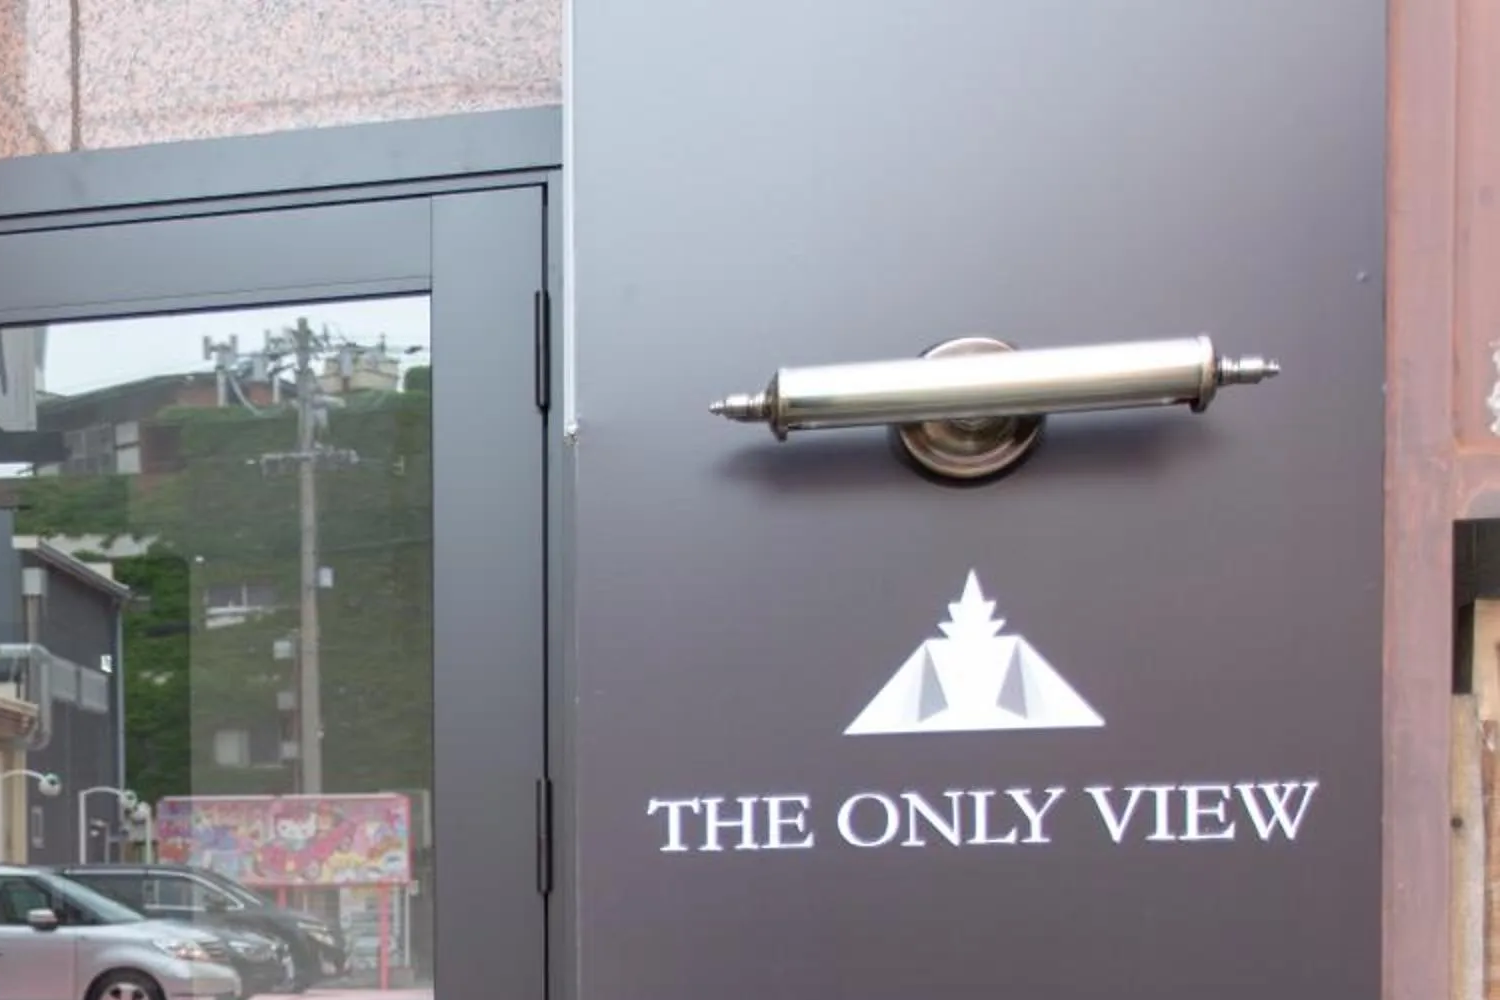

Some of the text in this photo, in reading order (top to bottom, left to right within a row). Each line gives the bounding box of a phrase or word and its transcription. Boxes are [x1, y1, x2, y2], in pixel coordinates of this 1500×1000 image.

[647, 780, 1319, 852] THE ONLY VIEW
